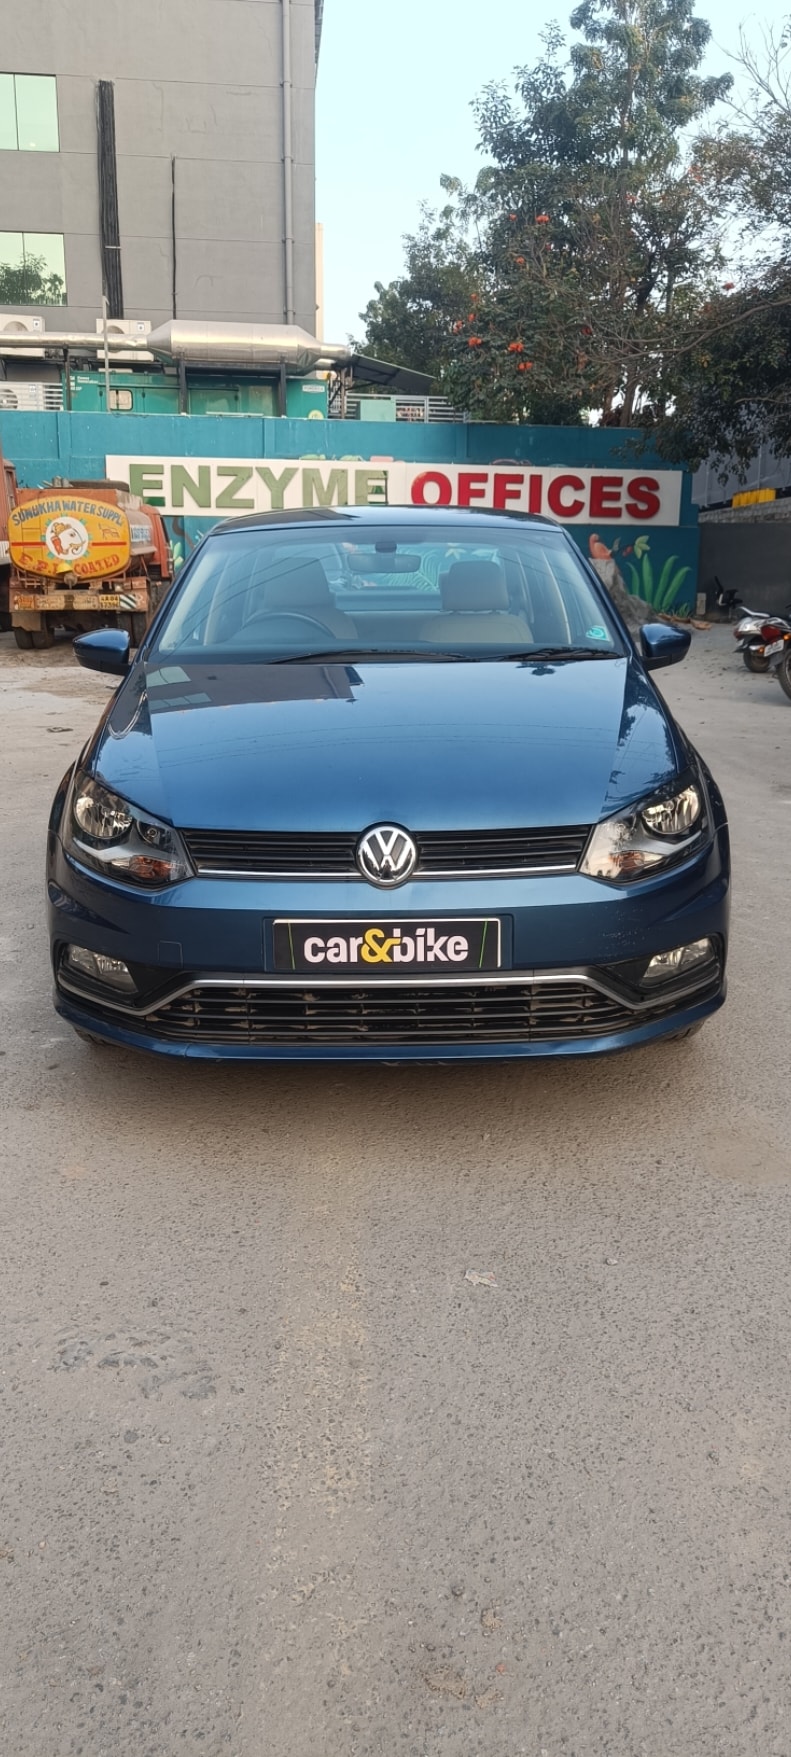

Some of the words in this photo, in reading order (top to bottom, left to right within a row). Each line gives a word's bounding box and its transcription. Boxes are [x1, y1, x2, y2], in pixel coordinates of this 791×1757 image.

[129, 463, 389, 508] ENZYME
[411, 470, 661, 519] OFFICES
[62, 500, 96, 514] WATER
[74, 554, 120, 575] COATED
[303, 927, 469, 964] car&bike
